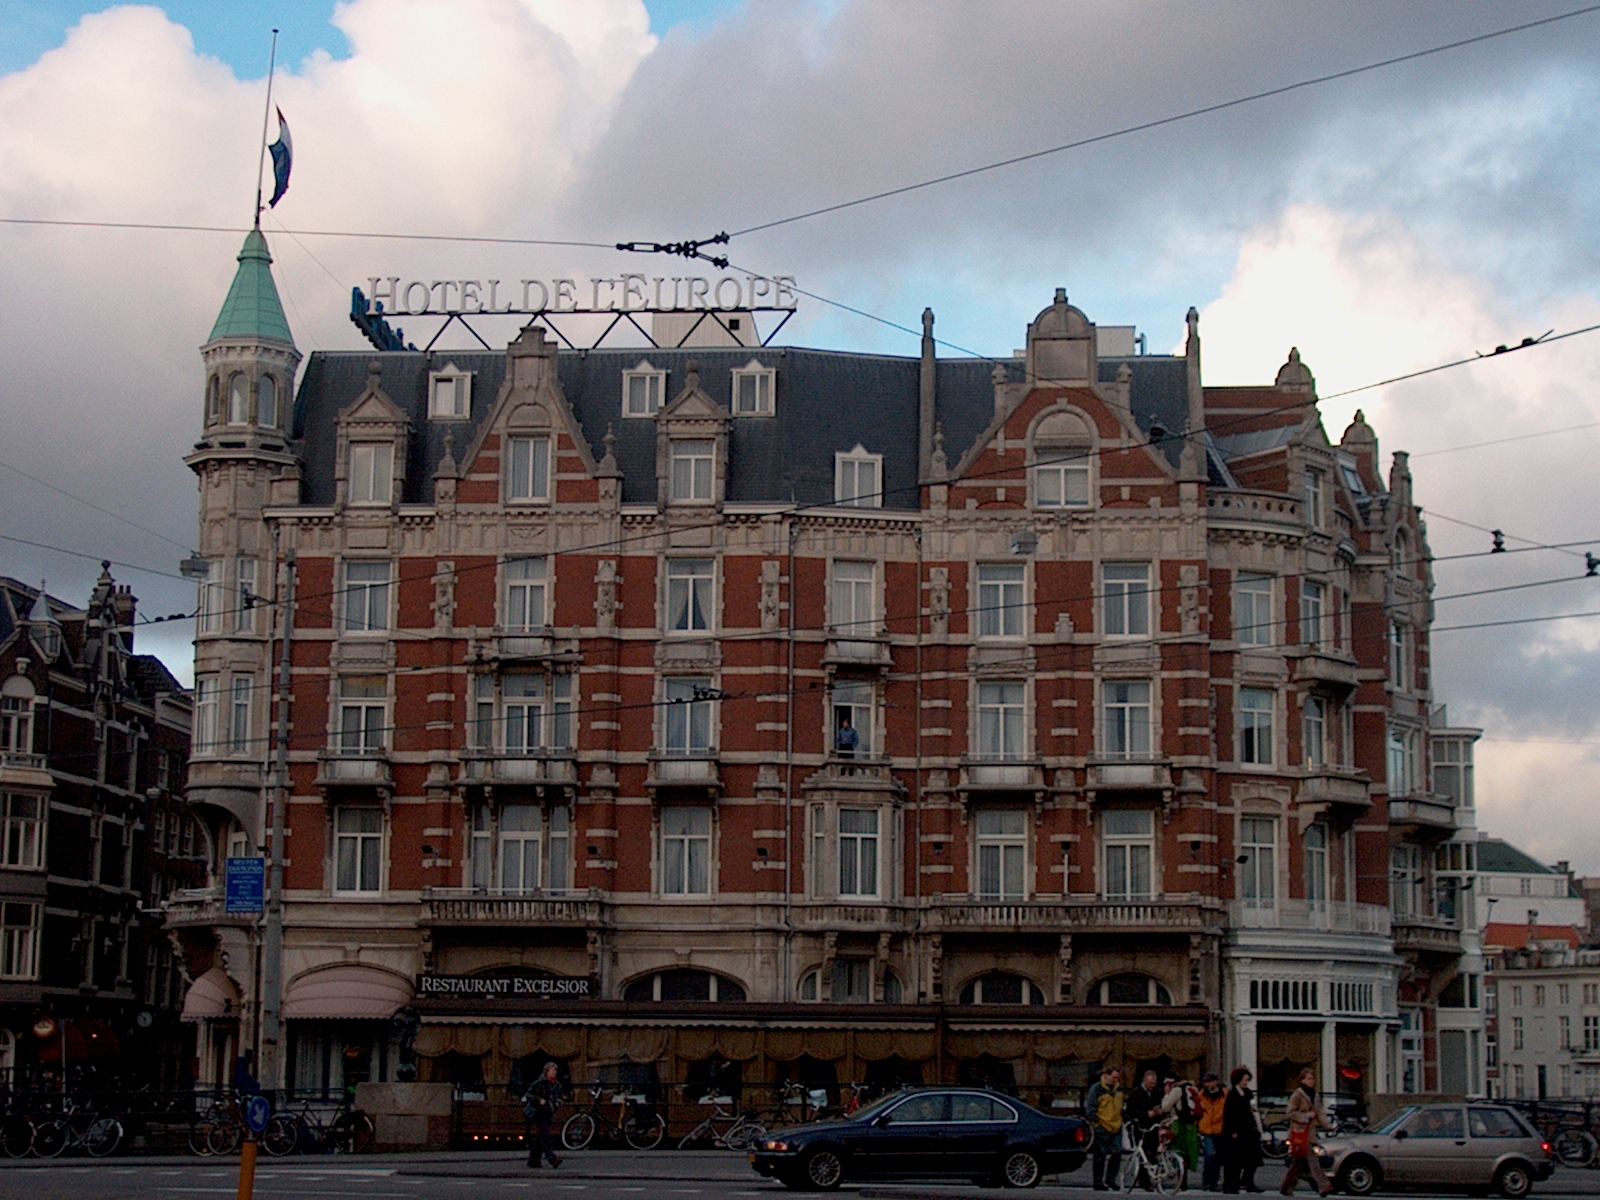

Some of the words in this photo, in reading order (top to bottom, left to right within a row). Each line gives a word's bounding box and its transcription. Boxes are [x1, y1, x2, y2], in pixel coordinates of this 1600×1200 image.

[366, 277, 512, 316] HOTEL
[520, 279, 578, 314] DE
[590, 273, 799, 312] L'EUROPE
[421, 977, 510, 993] RESTAURANT
[513, 978, 589, 994] EXCELSIOR
